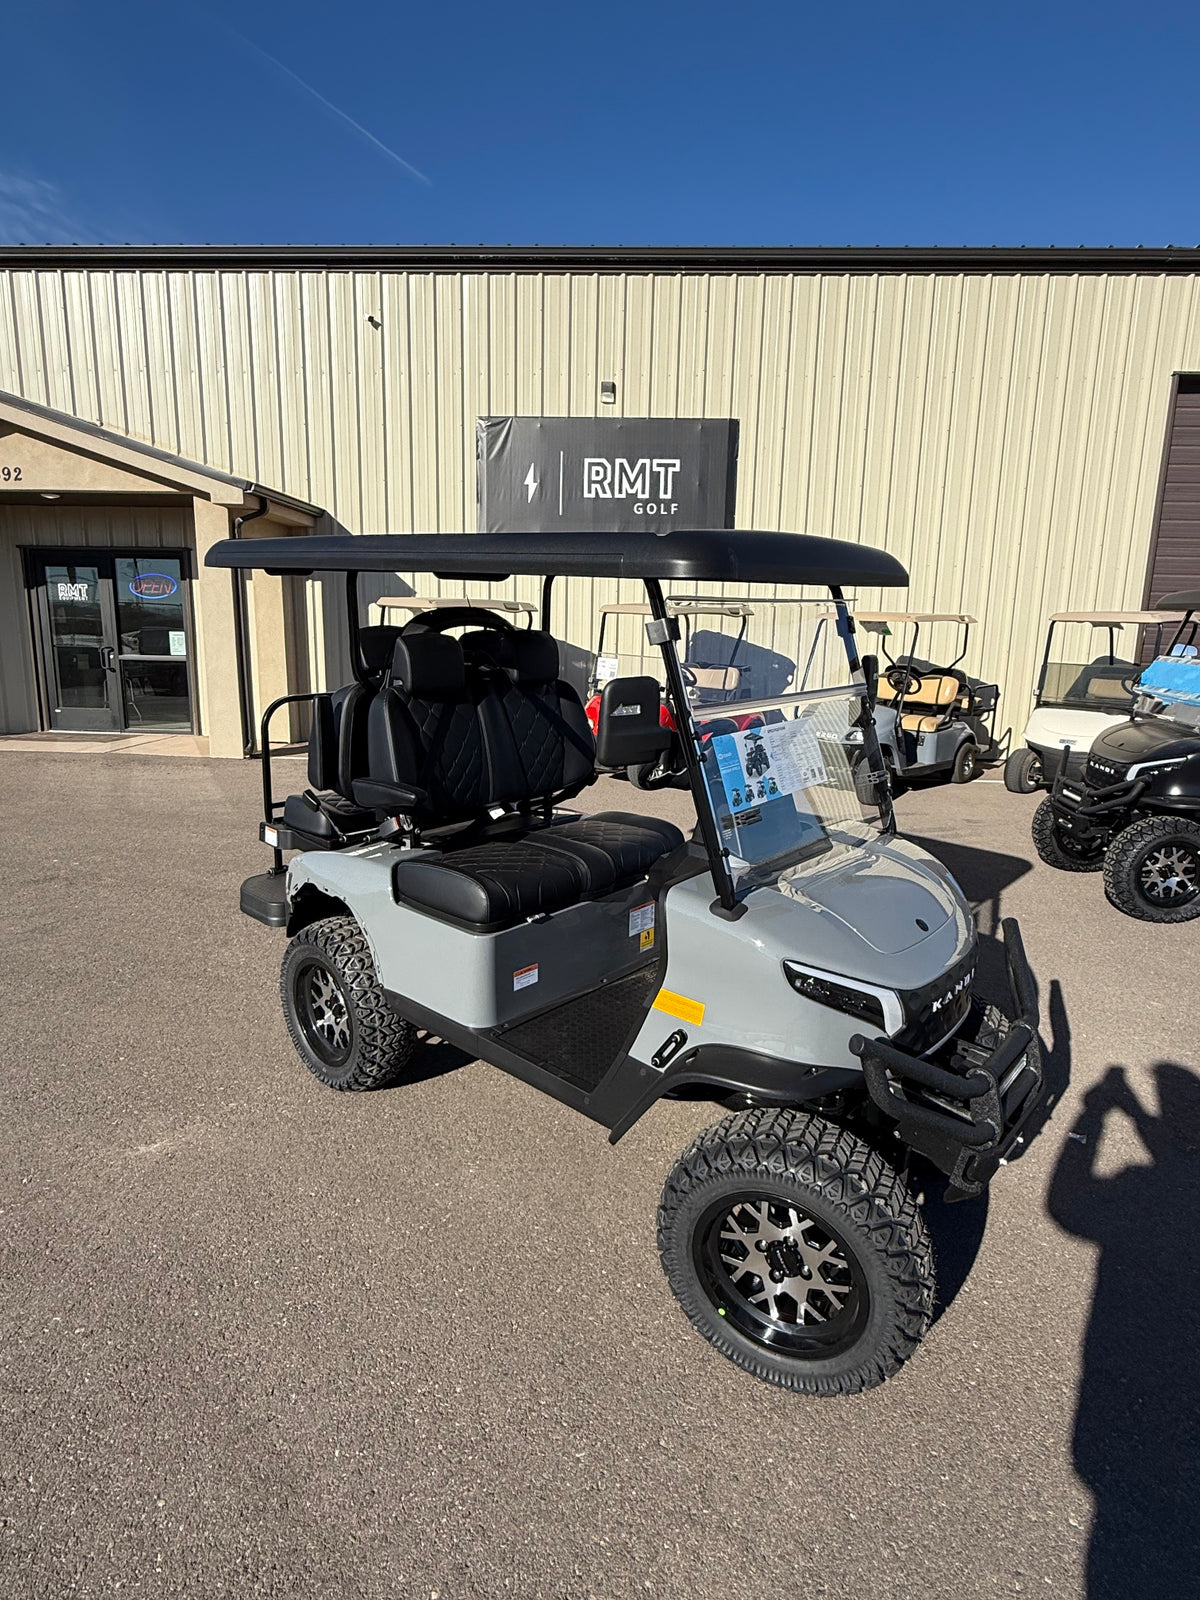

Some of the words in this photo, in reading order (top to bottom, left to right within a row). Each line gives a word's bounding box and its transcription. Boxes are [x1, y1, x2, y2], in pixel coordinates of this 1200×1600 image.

[0, 466, 23, 481] 92
[583, 457, 681, 499] RMT
[633, 502, 679, 515] GOLF
[57, 583, 88, 597] RMT
[132, 579, 173, 594] OPEN
[1090, 760, 1115, 775] KANDI
[931, 967, 975, 1013] KANDI
